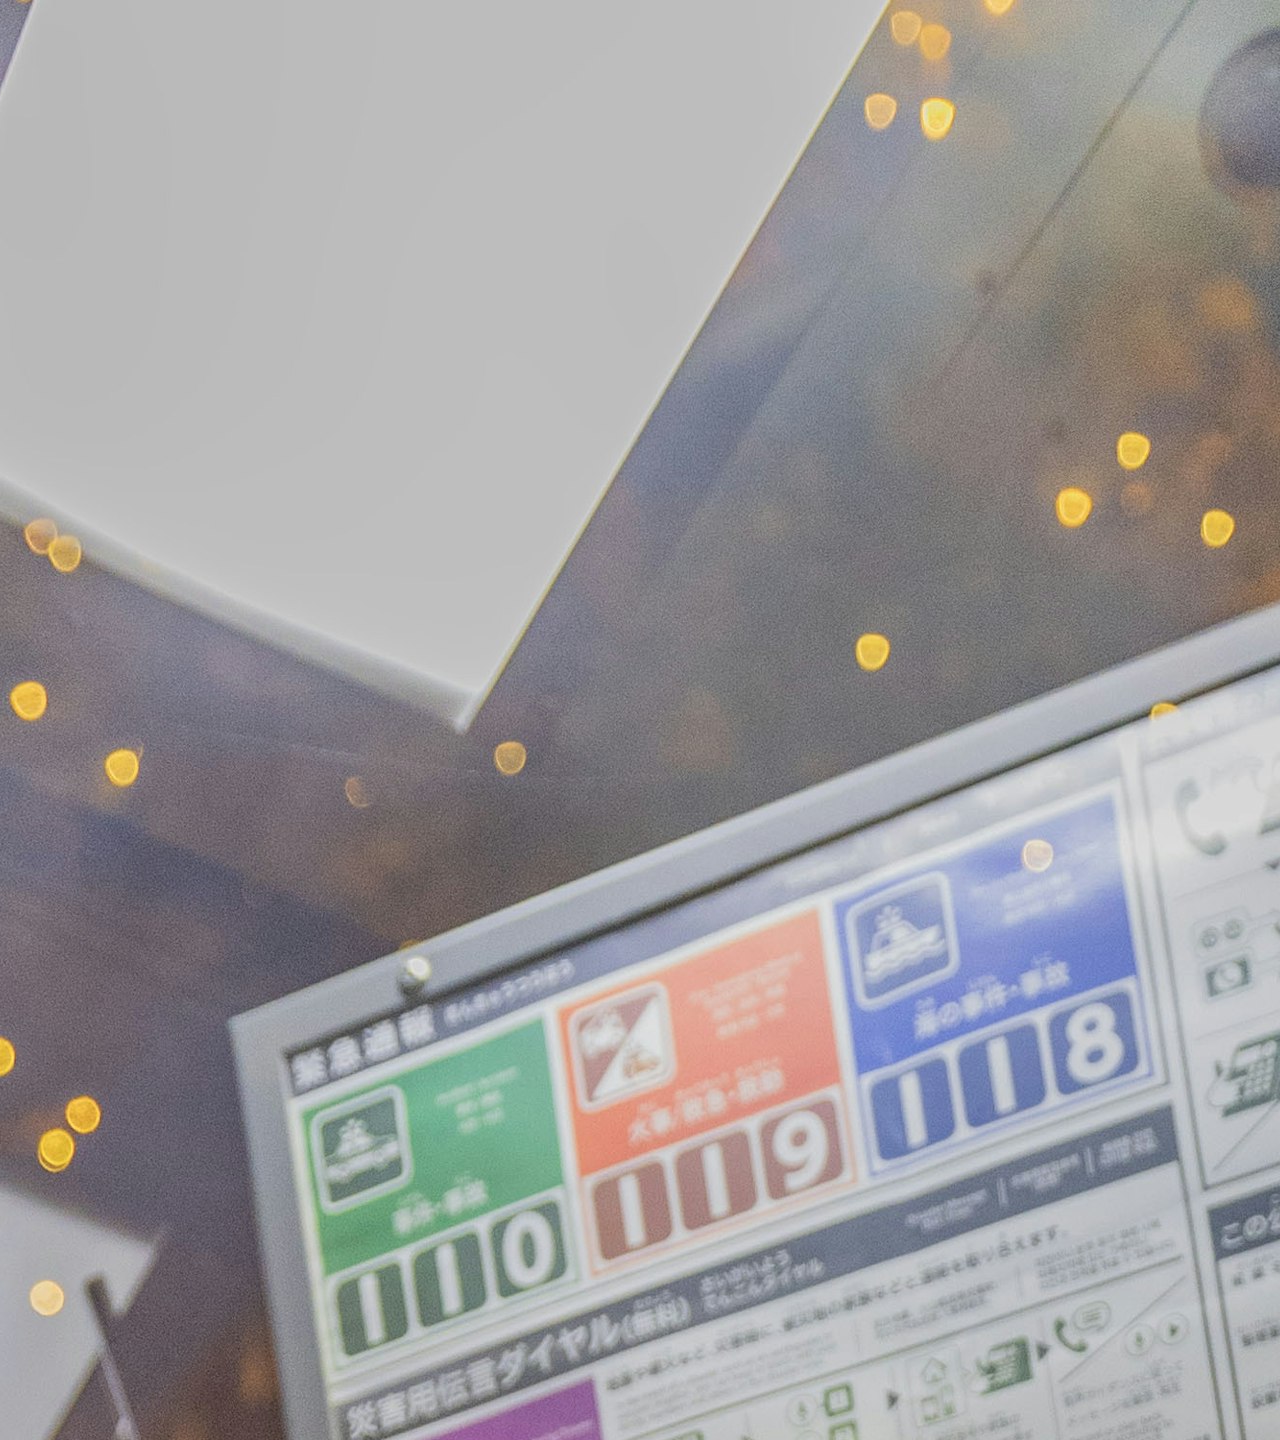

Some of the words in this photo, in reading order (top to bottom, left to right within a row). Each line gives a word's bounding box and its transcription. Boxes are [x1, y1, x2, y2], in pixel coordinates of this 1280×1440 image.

[900, 1001, 1124, 1149] 118
[618, 1110, 830, 1249] 119
[359, 1209, 560, 1348] 110
